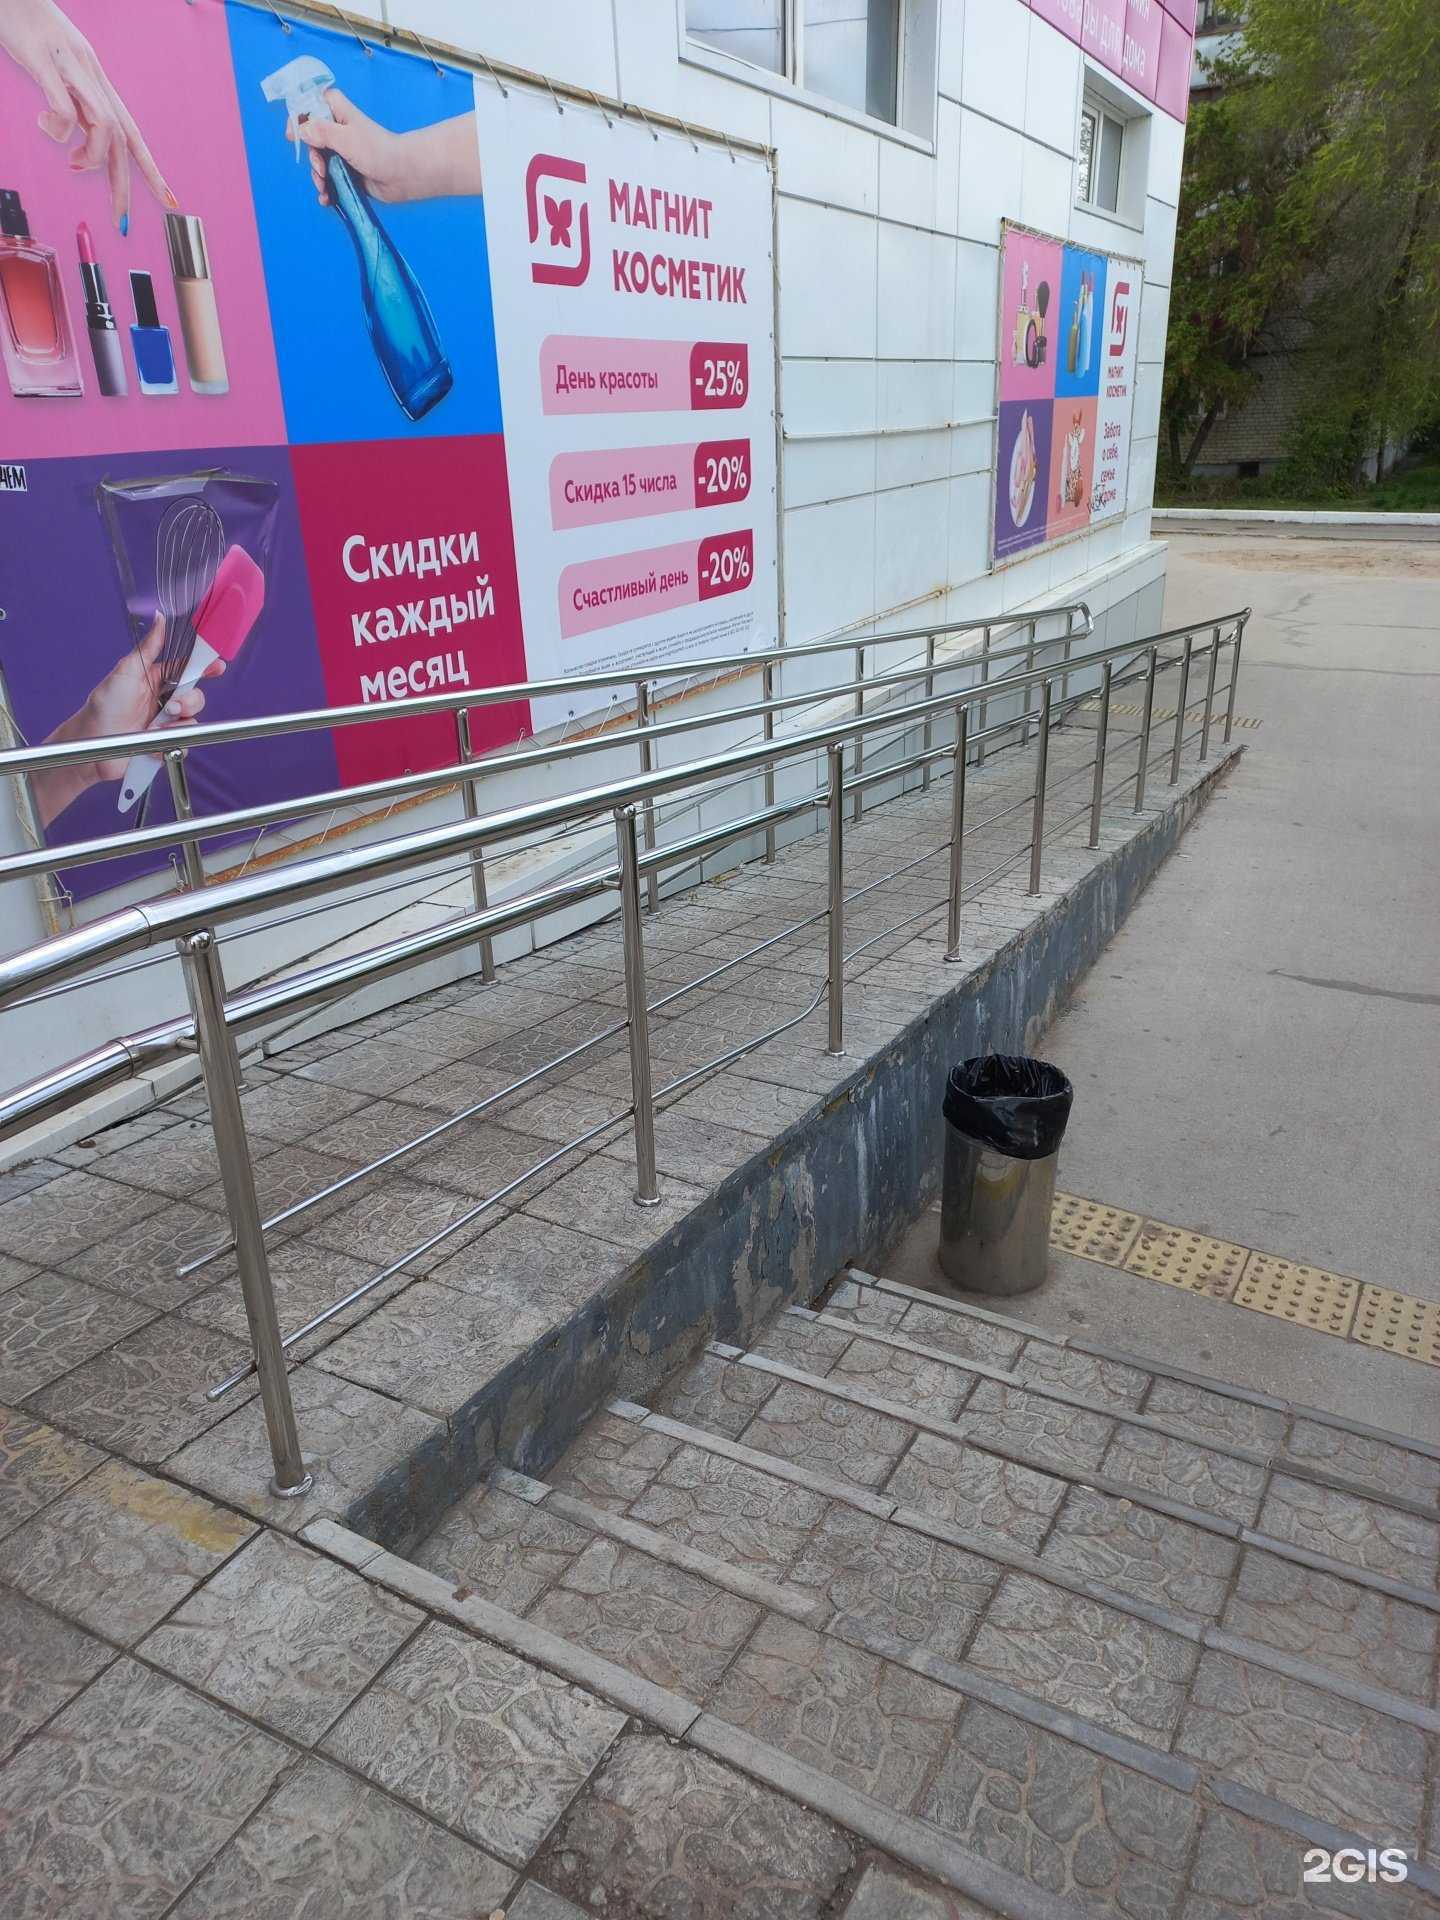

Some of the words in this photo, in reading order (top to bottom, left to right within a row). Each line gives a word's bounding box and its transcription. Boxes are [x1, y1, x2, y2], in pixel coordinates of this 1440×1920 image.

[1122, 33, 1146, 77] дома
[608, 178, 713, 239] МАГНИТ
[612, 249, 748, 304] КОСМЕТИК
[556, 364, 597, 393] День
[600, 370, 659, 395] красоты
[695, 359, 744, 398] -25%
[1103, 421, 1121, 439] Забота
[564, 479, 621, 504] Скидка
[622, 473, 637, 496] 15
[639, 473, 678, 494] числа
[698, 456, 747, 494] -20%
[342, 531, 480, 583] Скидки
[573, 571, 657, 611] Счастливый
[659, 570, 689, 594] день
[701, 545, 750, 586] -20%
[352, 574, 495, 647] каждый
[360, 650, 470, 704] месяц
